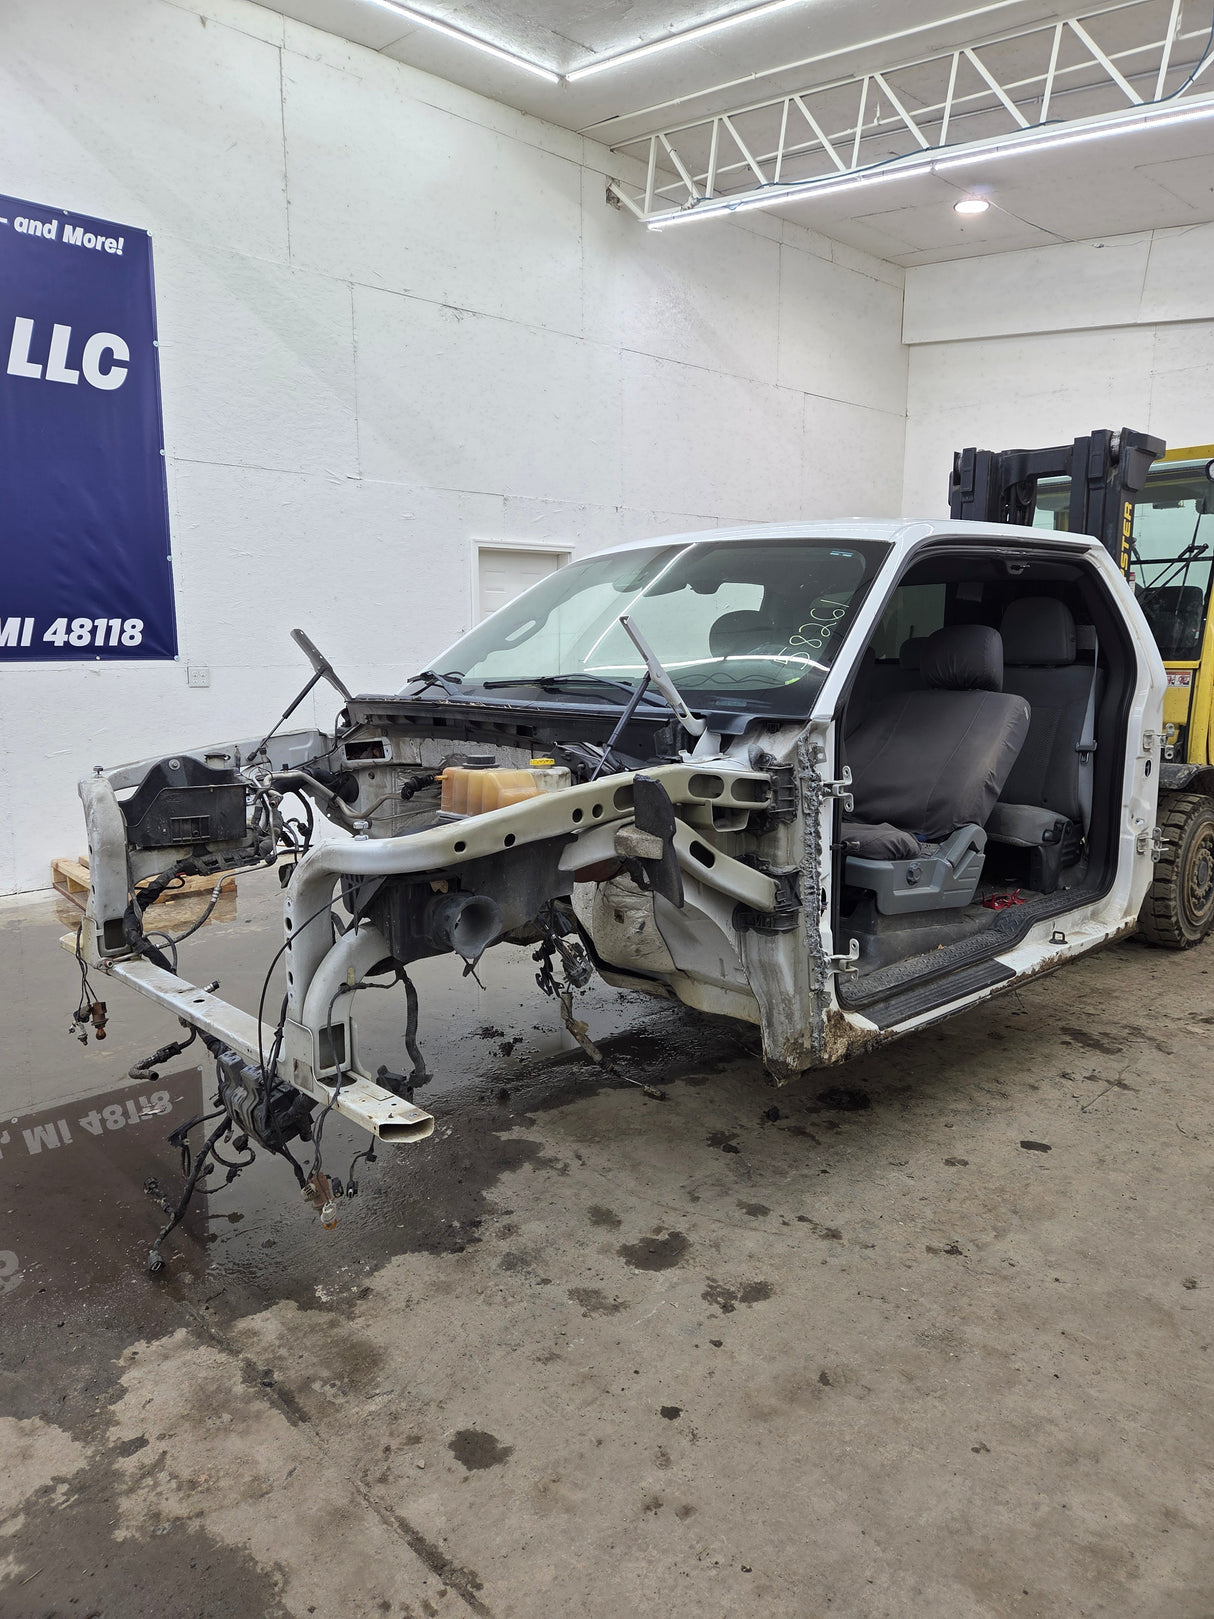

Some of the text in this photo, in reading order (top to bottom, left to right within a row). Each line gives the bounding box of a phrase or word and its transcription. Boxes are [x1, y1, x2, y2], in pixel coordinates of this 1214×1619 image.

[13, 216, 125, 256] and More!
[6, 316, 130, 391] LLC
[1119, 501, 1132, 578] STER
[0, 617, 144, 647] MI 48118
